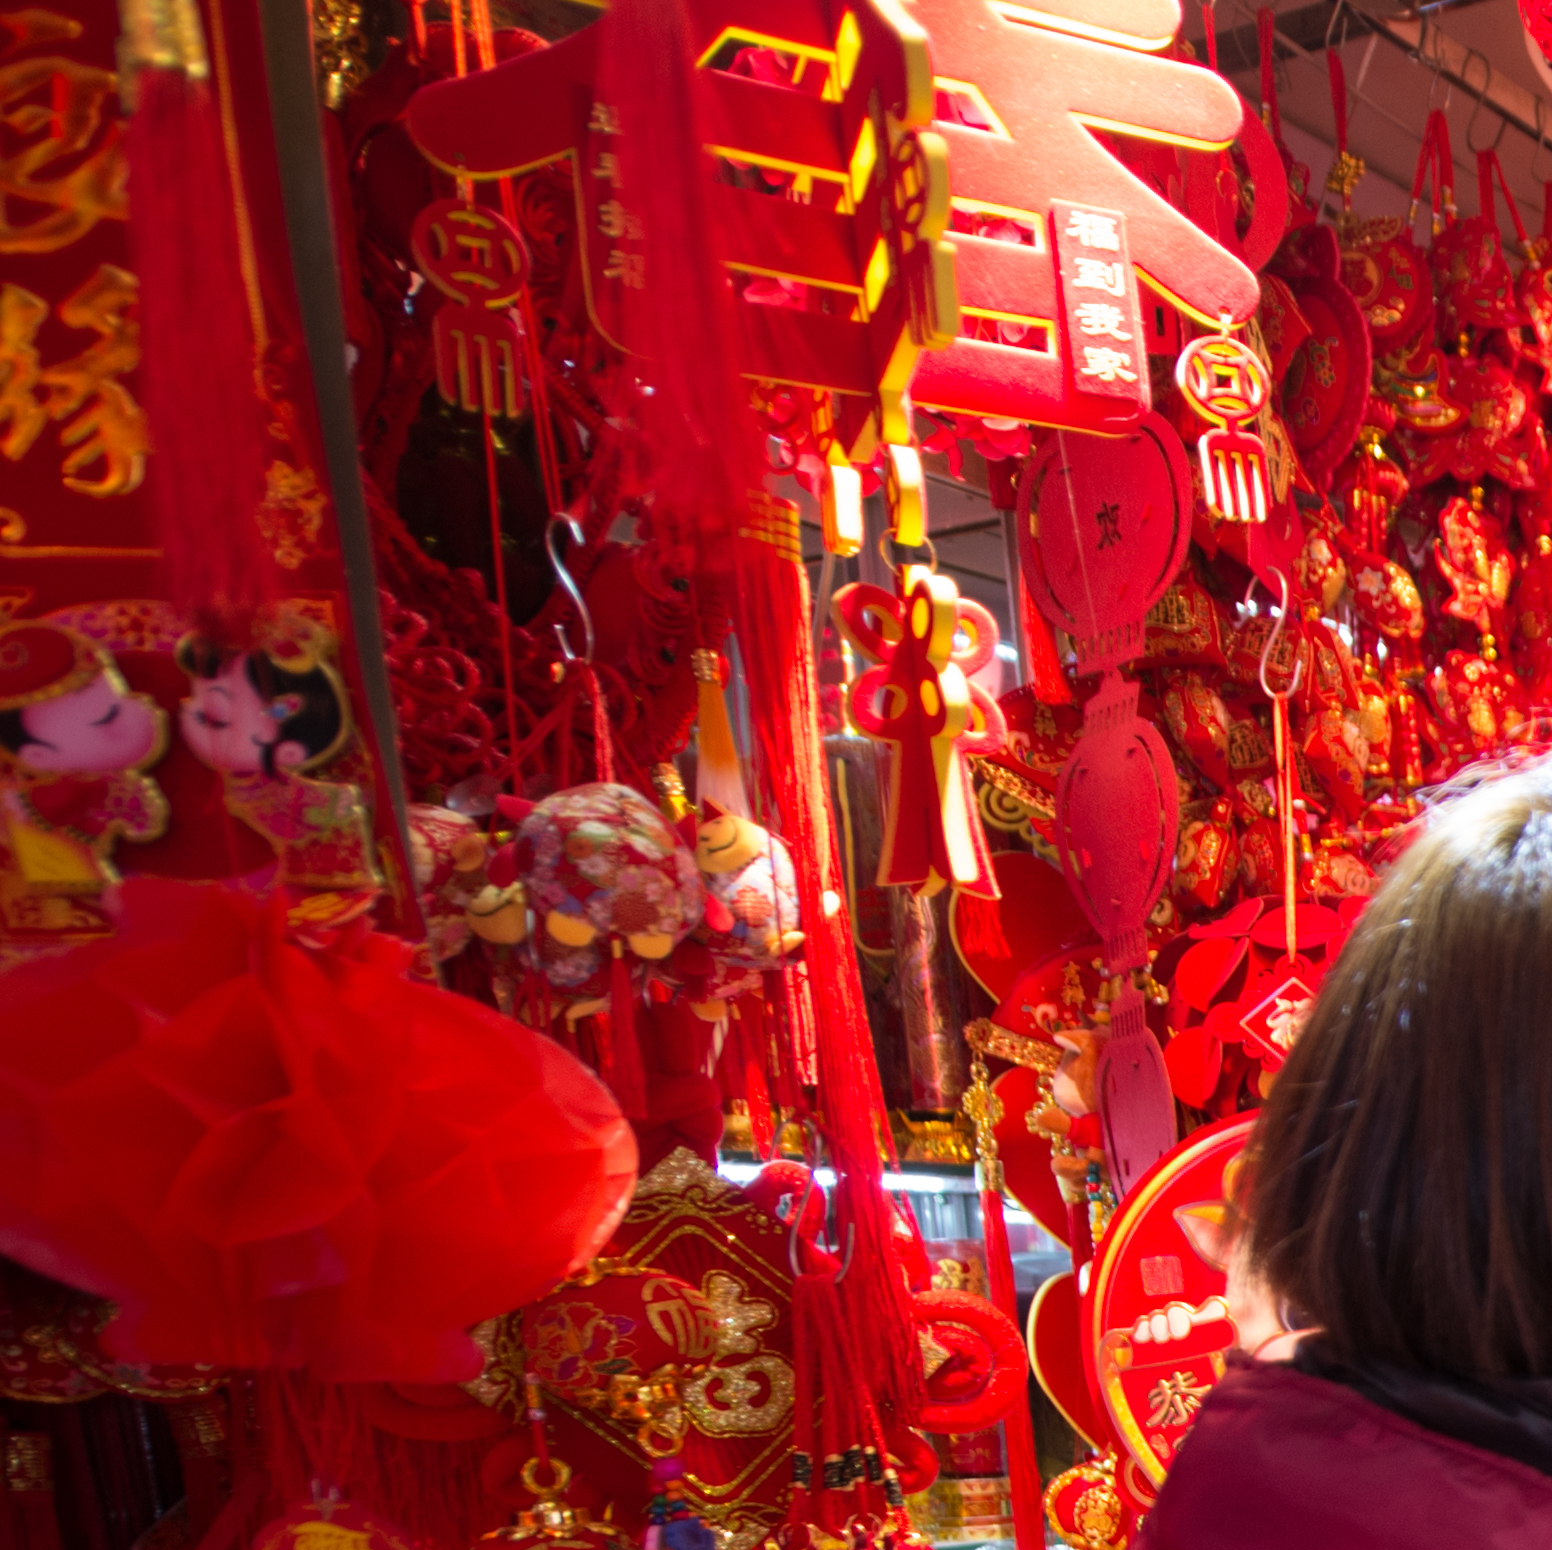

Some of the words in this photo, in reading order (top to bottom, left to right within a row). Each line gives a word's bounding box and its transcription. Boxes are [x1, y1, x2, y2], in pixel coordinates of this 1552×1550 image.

[1064, 210, 1138, 383] 福到我家
[1145, 1370, 1214, 1429] 恭
